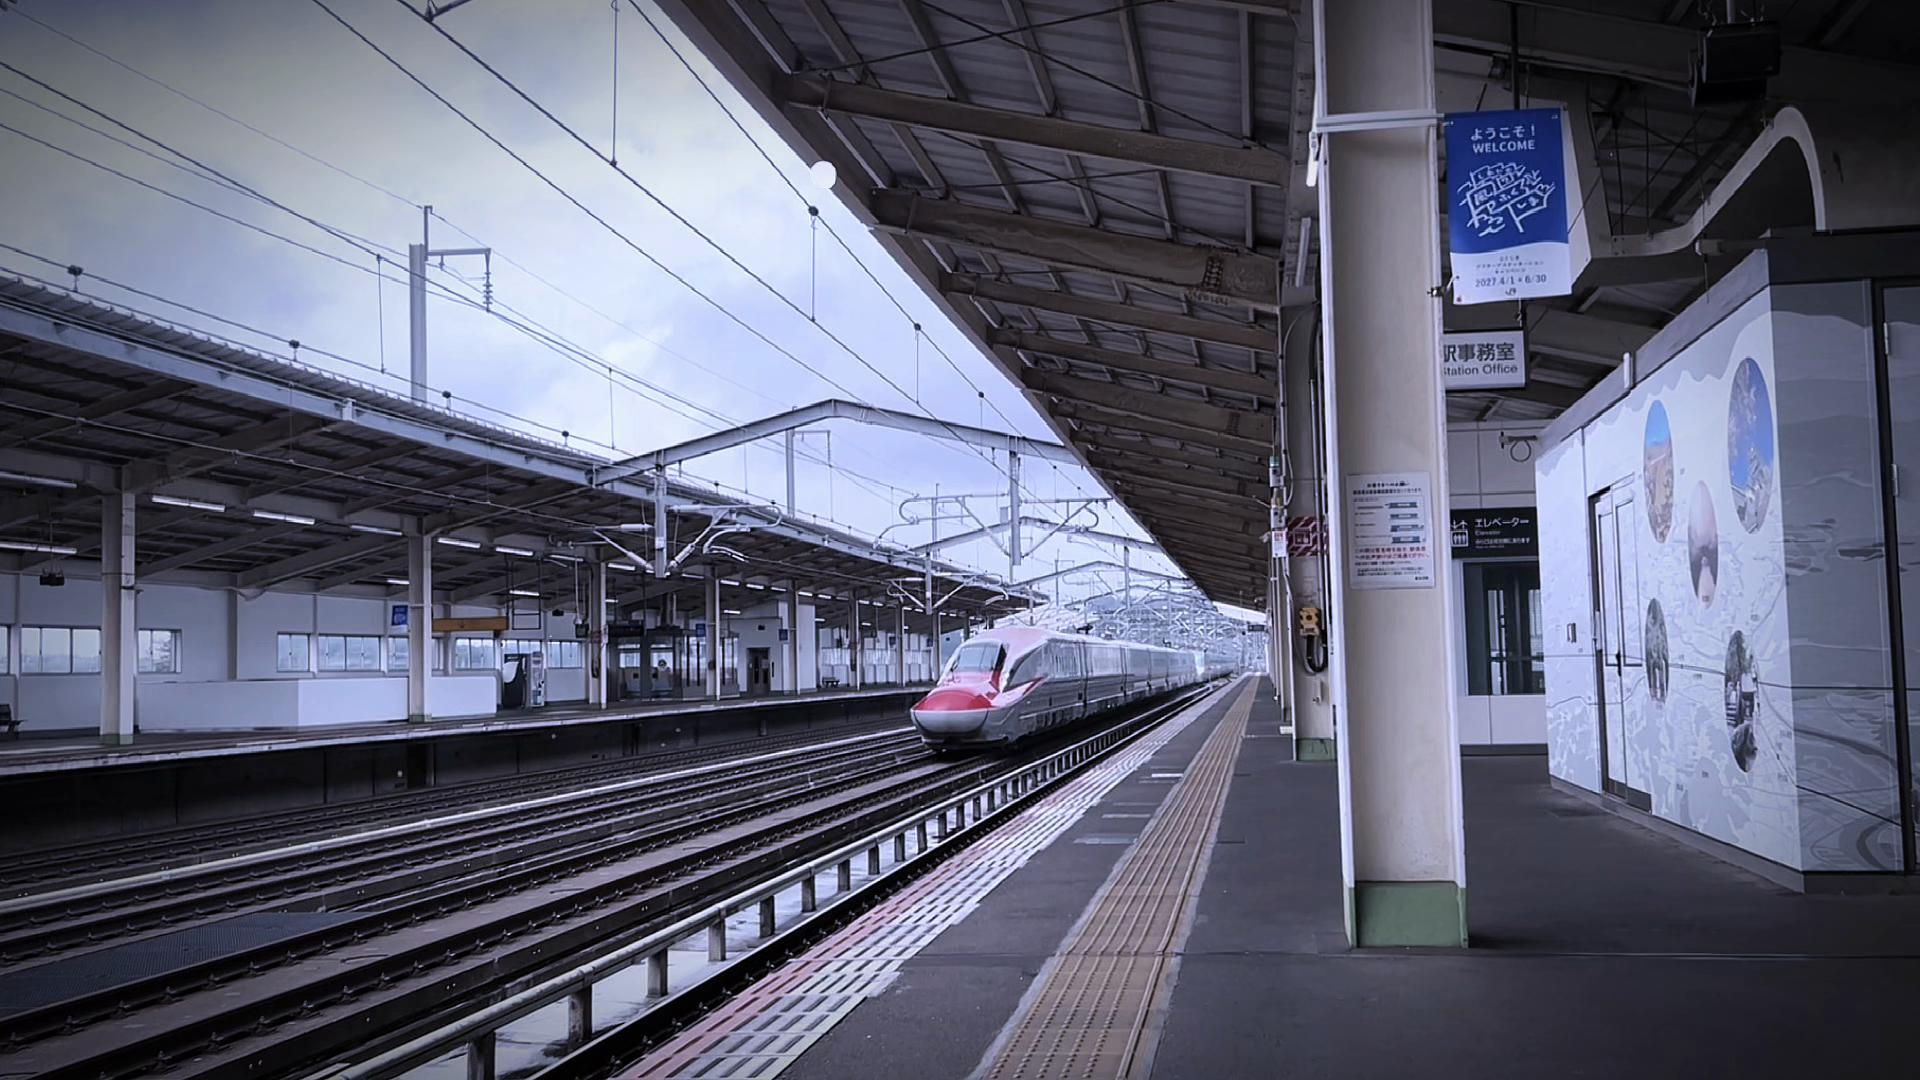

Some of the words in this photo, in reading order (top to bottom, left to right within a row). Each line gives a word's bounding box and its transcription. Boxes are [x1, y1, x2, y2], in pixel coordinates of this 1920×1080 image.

[1473, 140, 1535, 153] WELCOME
[1482, 363, 1518, 375] Office
[1475, 517, 1530, 528] エレベーター
